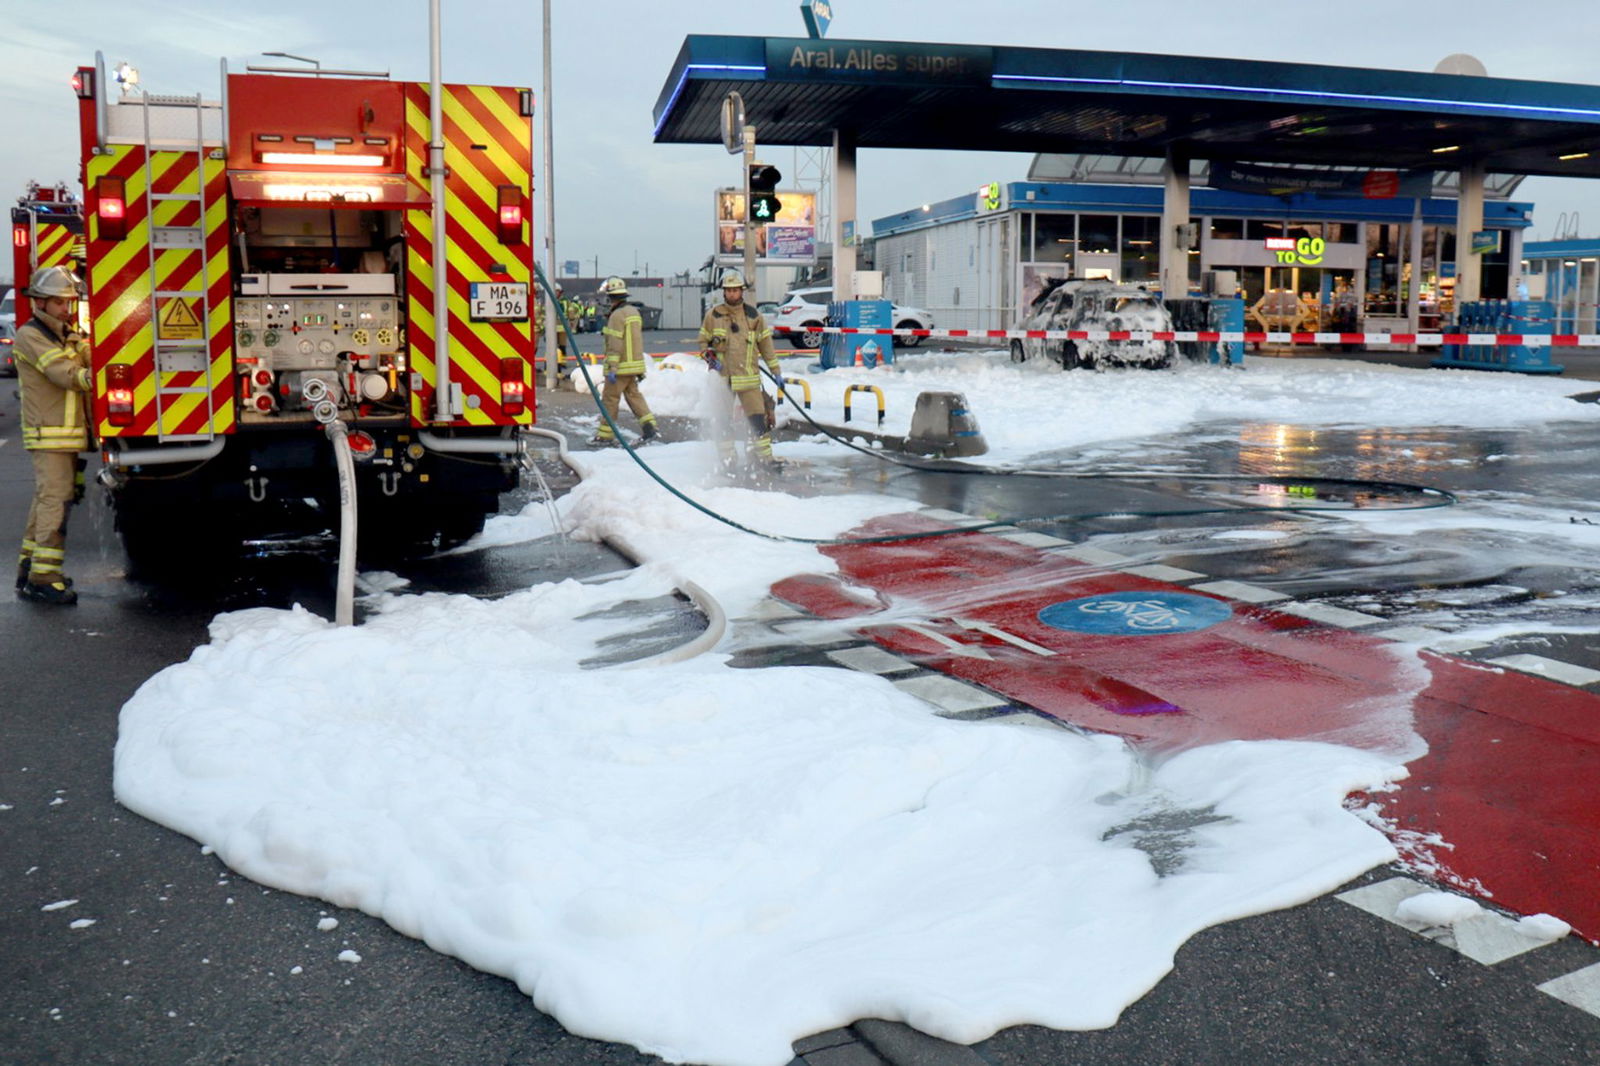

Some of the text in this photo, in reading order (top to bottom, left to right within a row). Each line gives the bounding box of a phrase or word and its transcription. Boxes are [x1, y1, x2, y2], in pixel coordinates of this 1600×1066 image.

[790, 47, 840, 68] Aral.
[845, 49, 897, 71] Alles
[1297, 238, 1324, 255] GO
[1276, 251, 1295, 263] TO
[490, 286, 508, 299] MA
[477, 301, 522, 315] F 196
